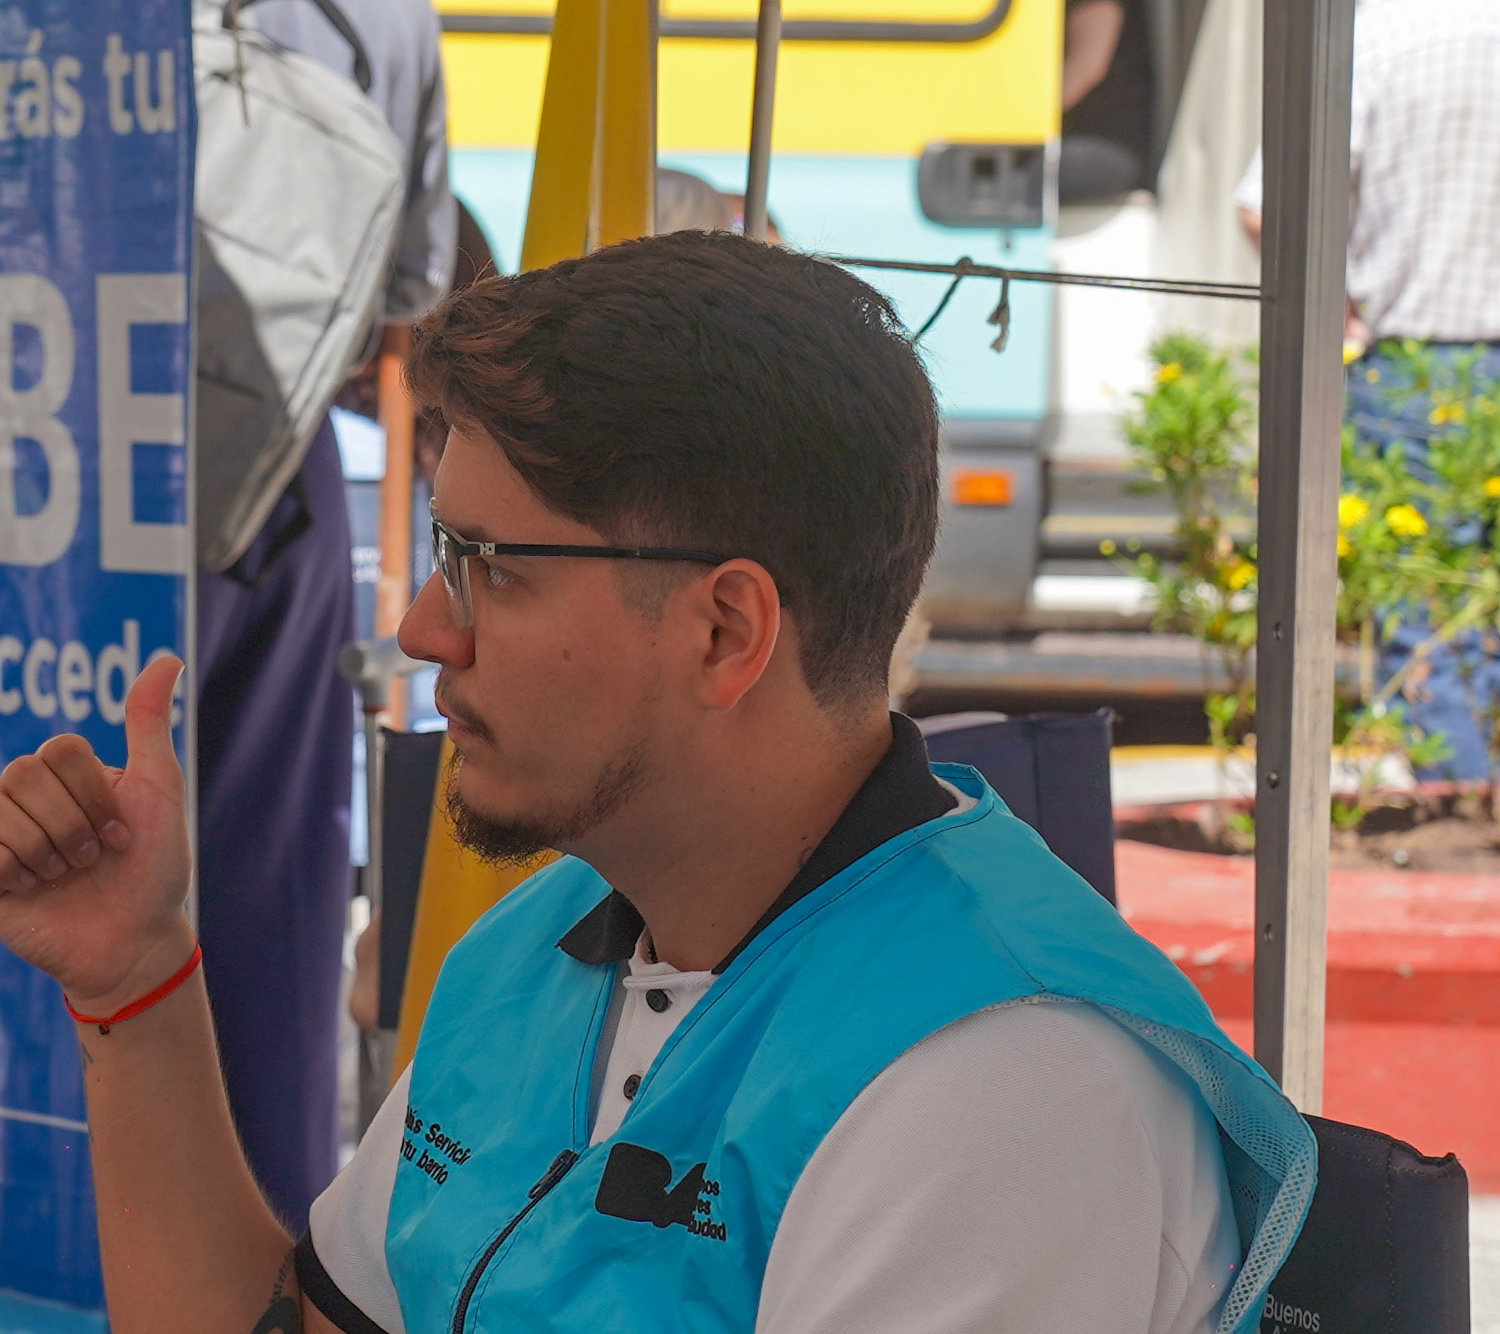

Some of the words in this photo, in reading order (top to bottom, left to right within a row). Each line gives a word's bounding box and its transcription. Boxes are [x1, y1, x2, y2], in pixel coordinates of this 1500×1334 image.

[104, 34, 177, 137] tu
[416, 1148, 449, 1186] barrio
[1263, 1293, 1321, 1333] Buenos
